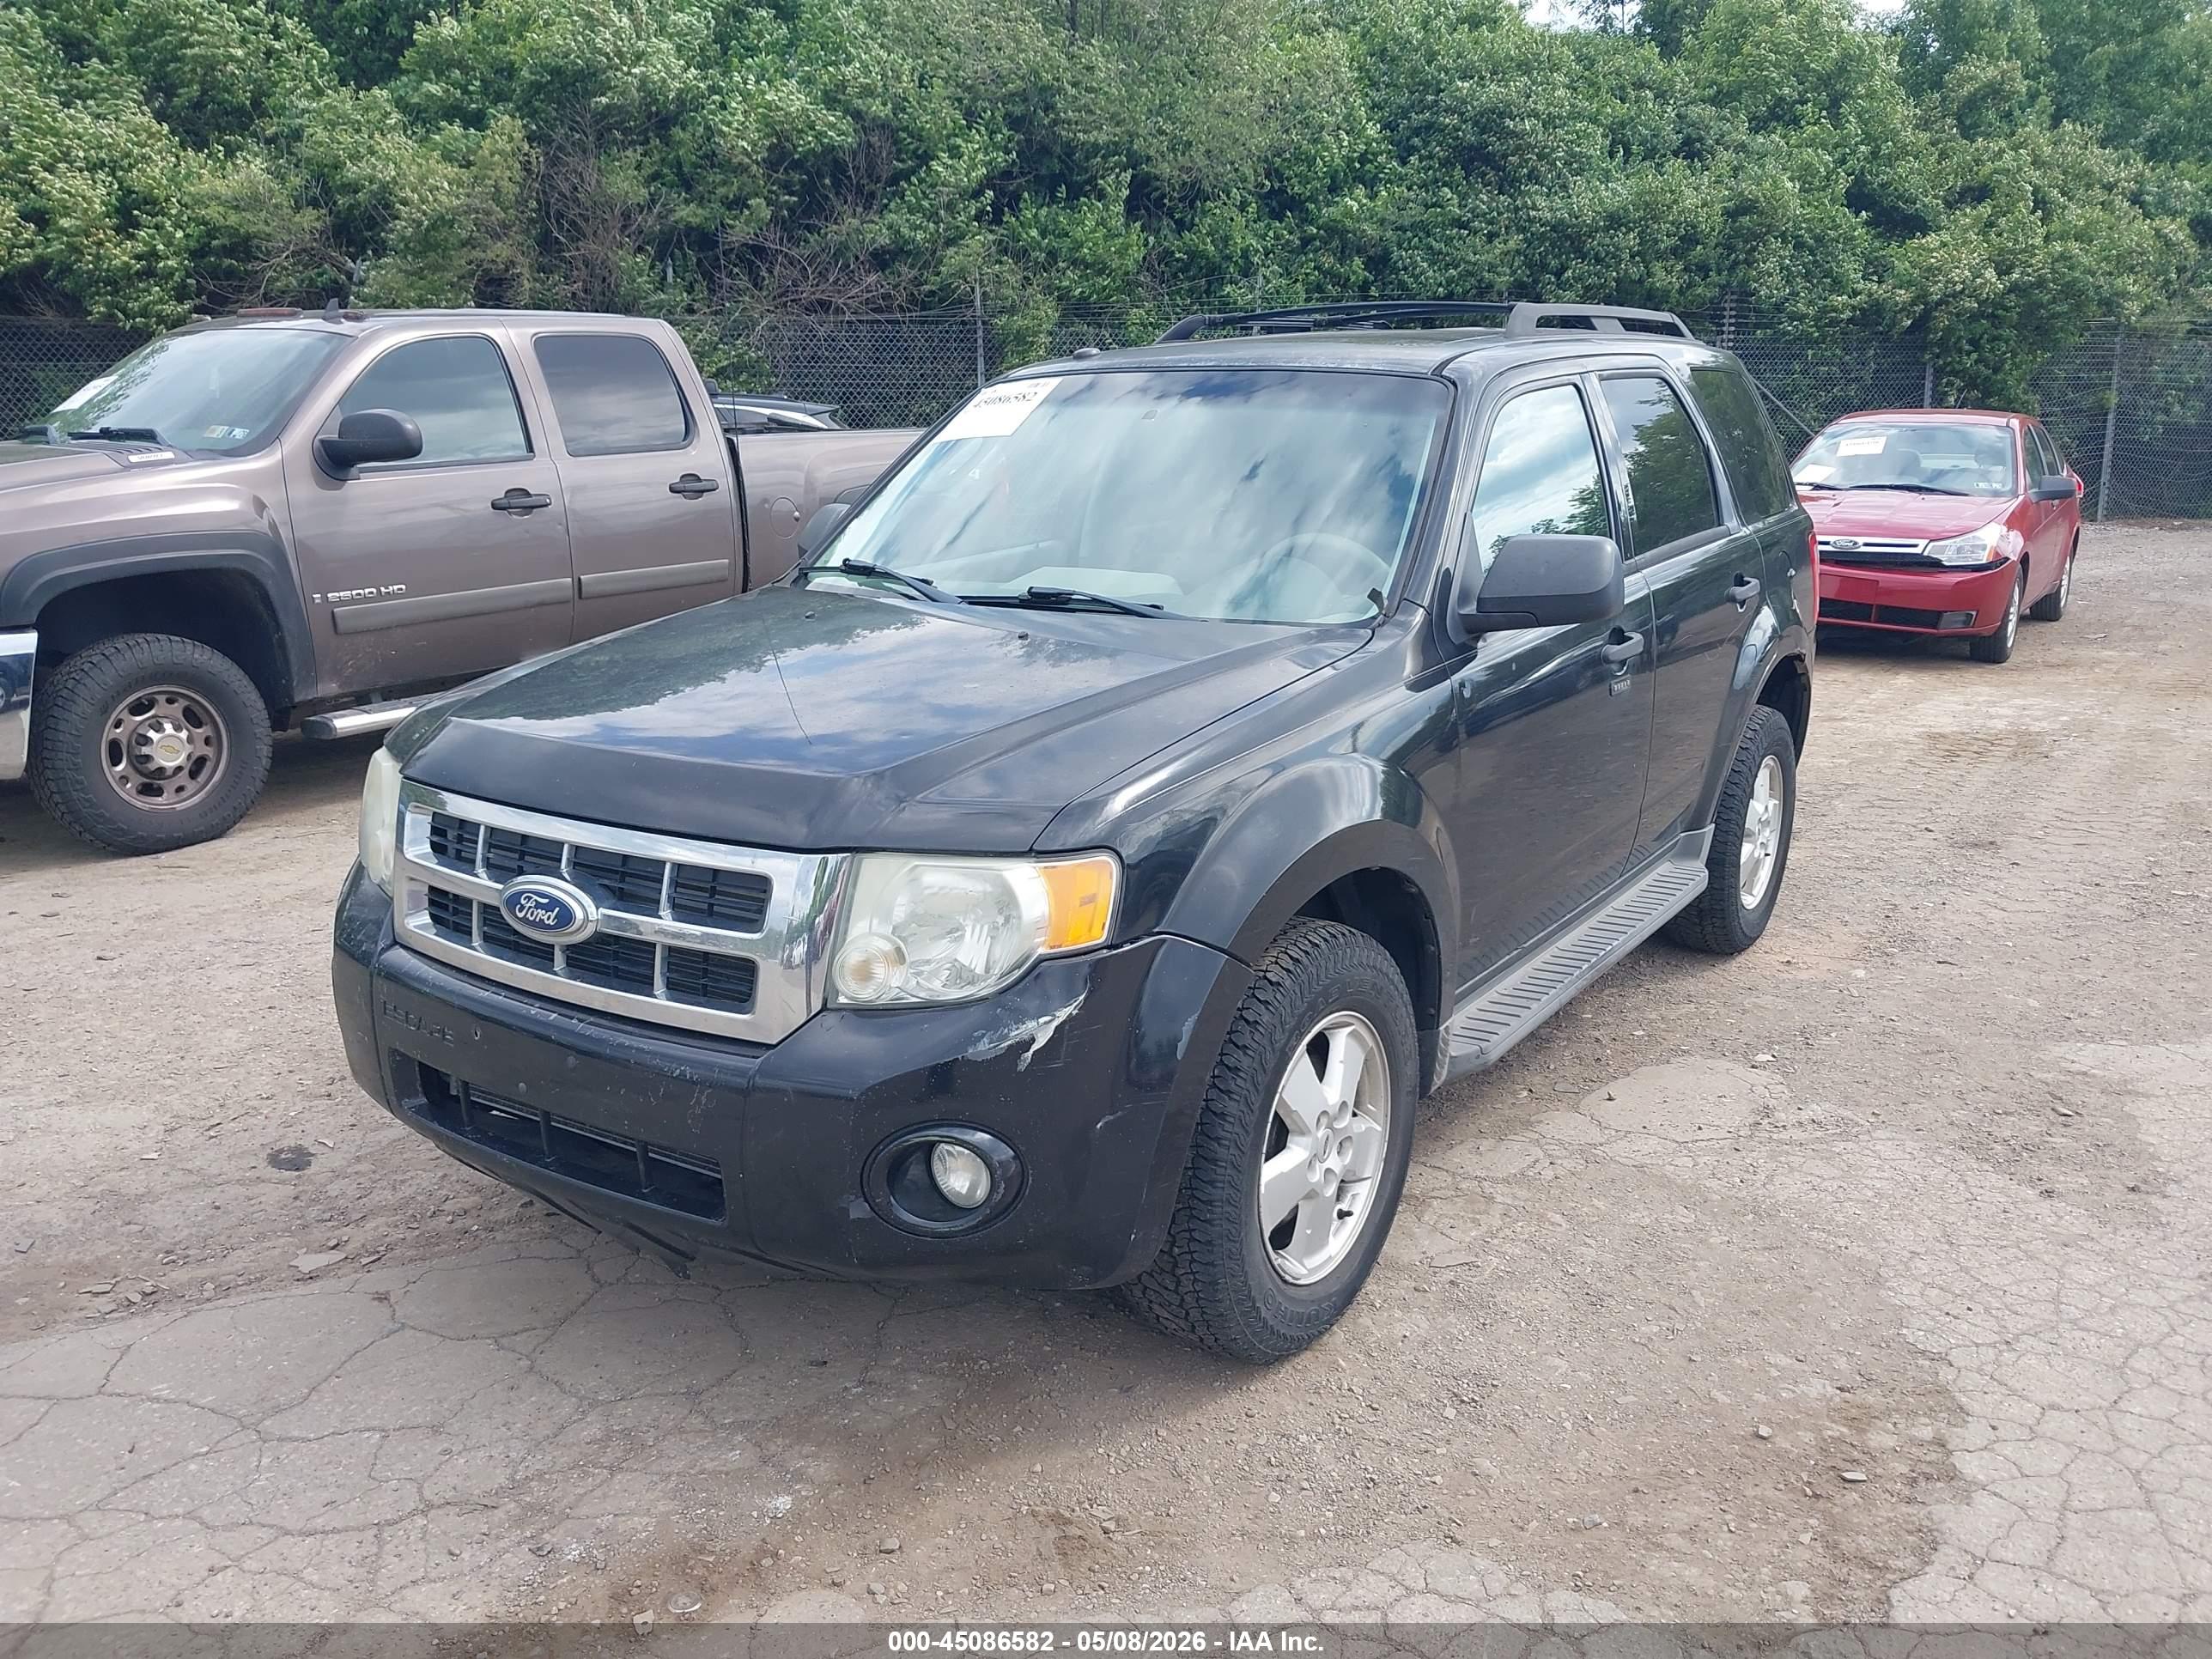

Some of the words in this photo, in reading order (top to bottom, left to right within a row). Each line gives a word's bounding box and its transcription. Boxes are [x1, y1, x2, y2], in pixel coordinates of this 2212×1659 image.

[327, 587, 377, 602] 2500
[380, 584, 406, 596] HD
[515, 892, 560, 926] Ford
[383, 1000, 454, 1048] ESCAPE
